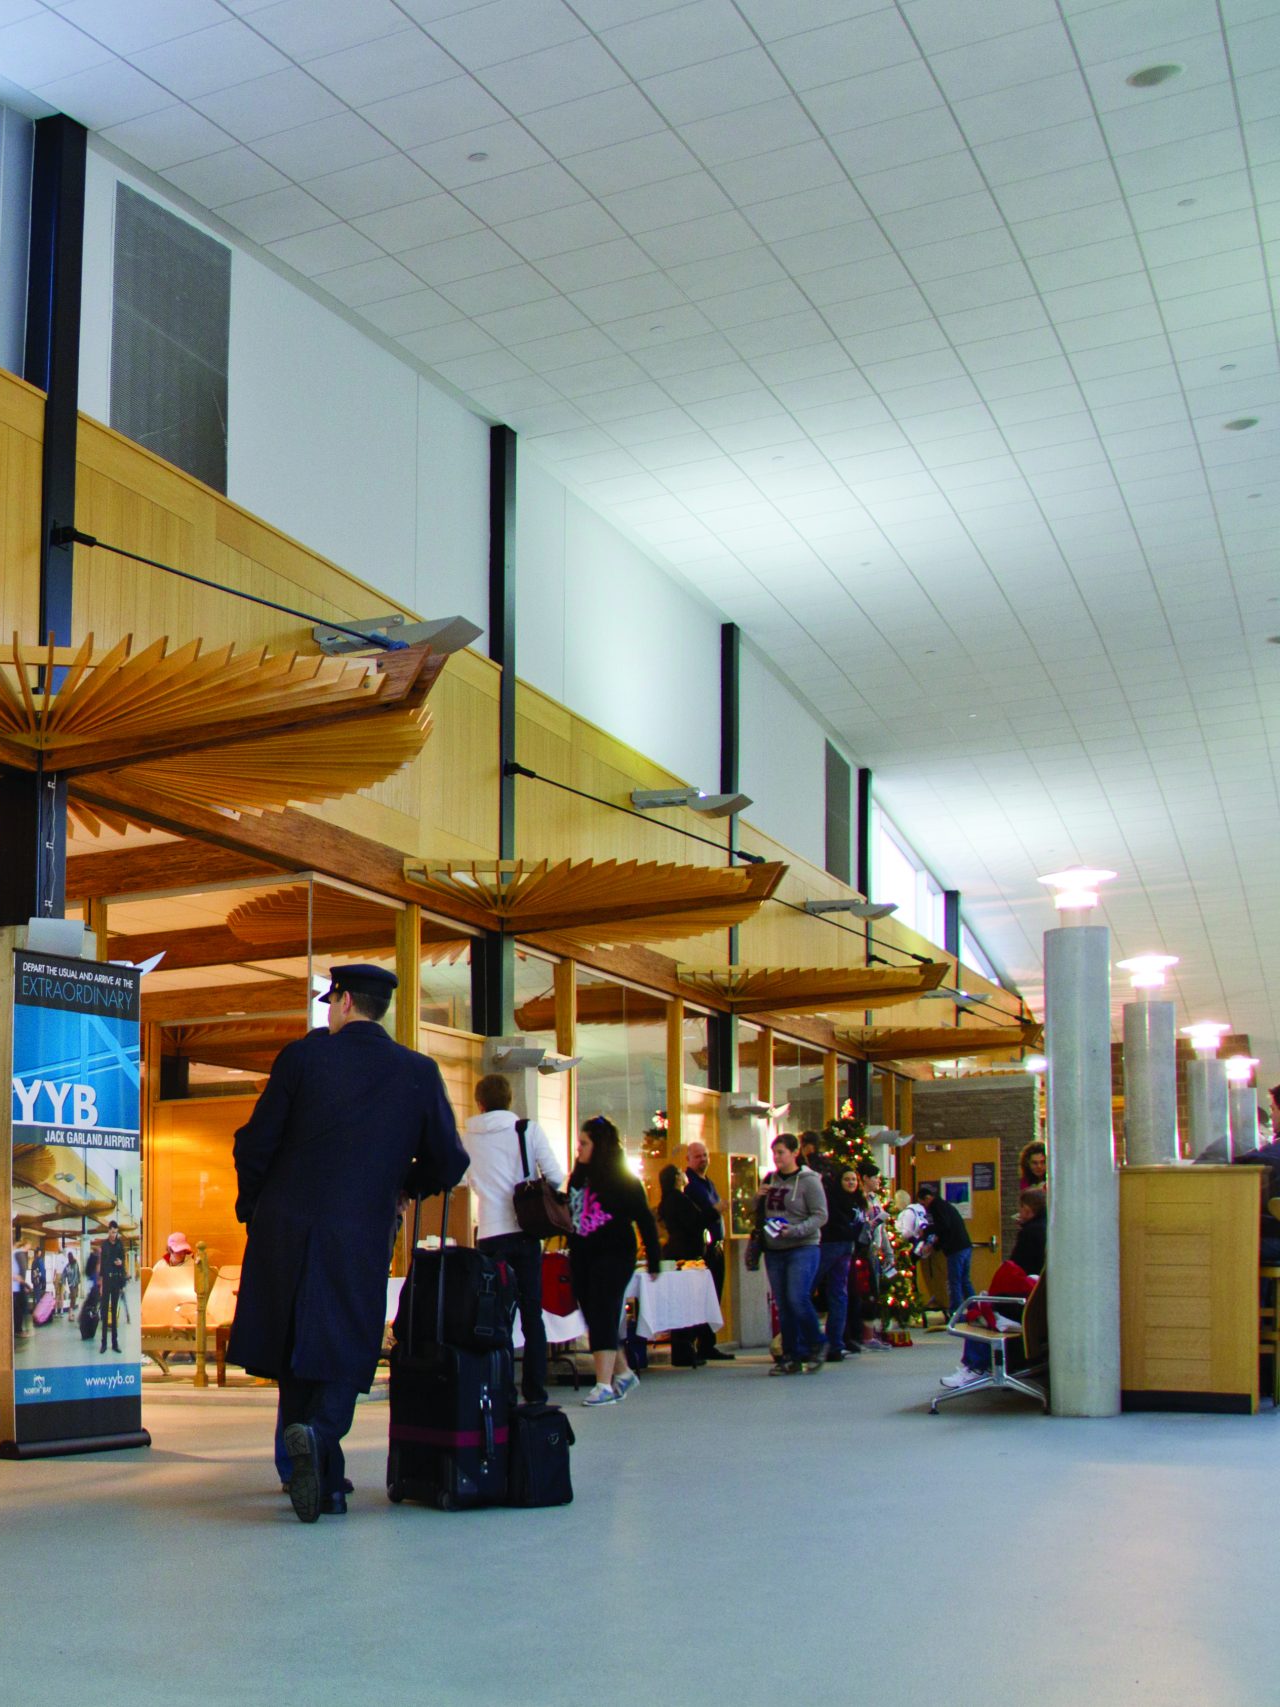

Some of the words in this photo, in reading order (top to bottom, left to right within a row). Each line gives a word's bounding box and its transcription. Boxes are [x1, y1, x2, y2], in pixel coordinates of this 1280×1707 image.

[23, 962, 45, 973] DEPART
[46, 965, 57, 976] THE
[59, 967, 78, 979] USUAL
[79, 971, 93, 981] AND
[94, 973, 114, 985] ARRIVE
[115, 976, 122, 986] AT
[123, 979, 133, 989] THE
[22, 976, 132, 1010] EXTRAORDINARY
[12, 1077, 99, 1128] YYB
[45, 1130, 65, 1143] JACK
[66, 1131, 102, 1146] GARLAND
[103, 1135, 136, 1149] AIRPORT
[768, 1188, 790, 1211] H
[85, 1370, 135, 1389] www.yyb.ca
